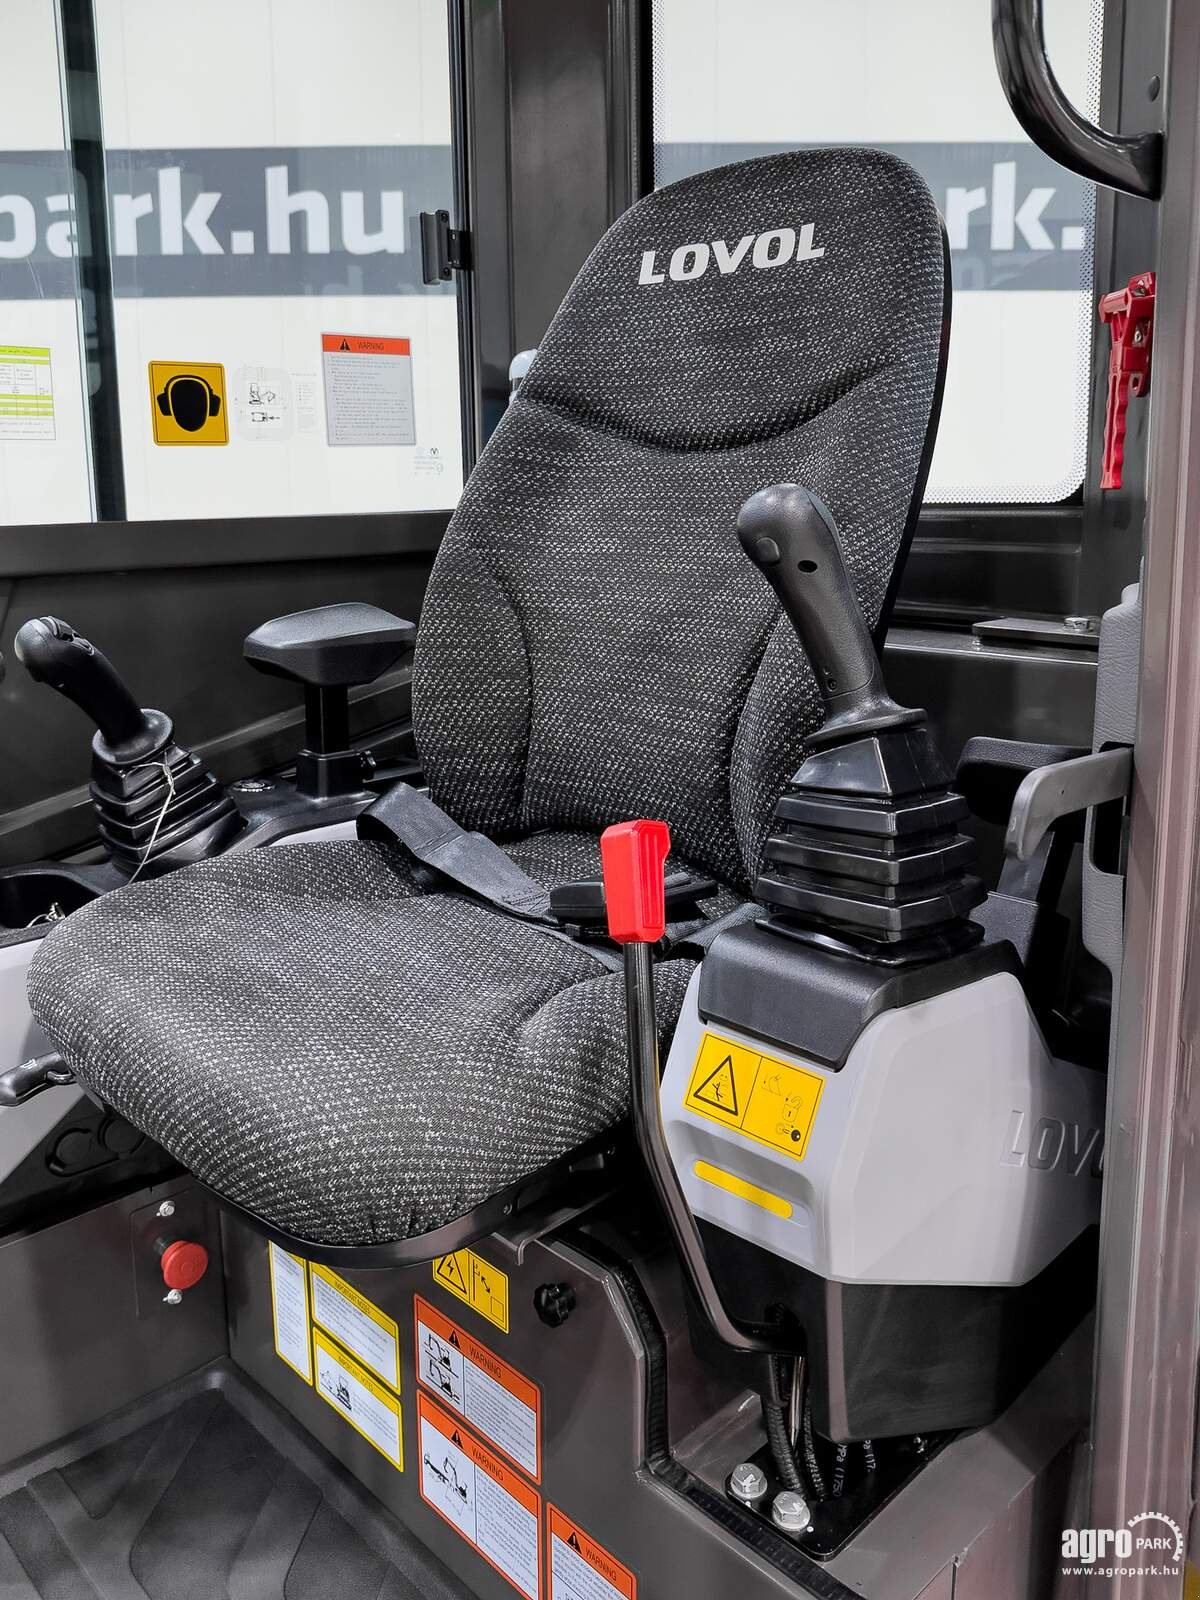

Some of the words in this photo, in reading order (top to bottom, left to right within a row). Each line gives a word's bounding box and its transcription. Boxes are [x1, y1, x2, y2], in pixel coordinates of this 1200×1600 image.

[638, 223, 825, 285] LOVOL
[357, 341, 385, 351] WARNING
[469, 1345, 502, 1378] WARNING
[472, 1445, 504, 1481] WARNING
[585, 1547, 617, 1582] WARNING
